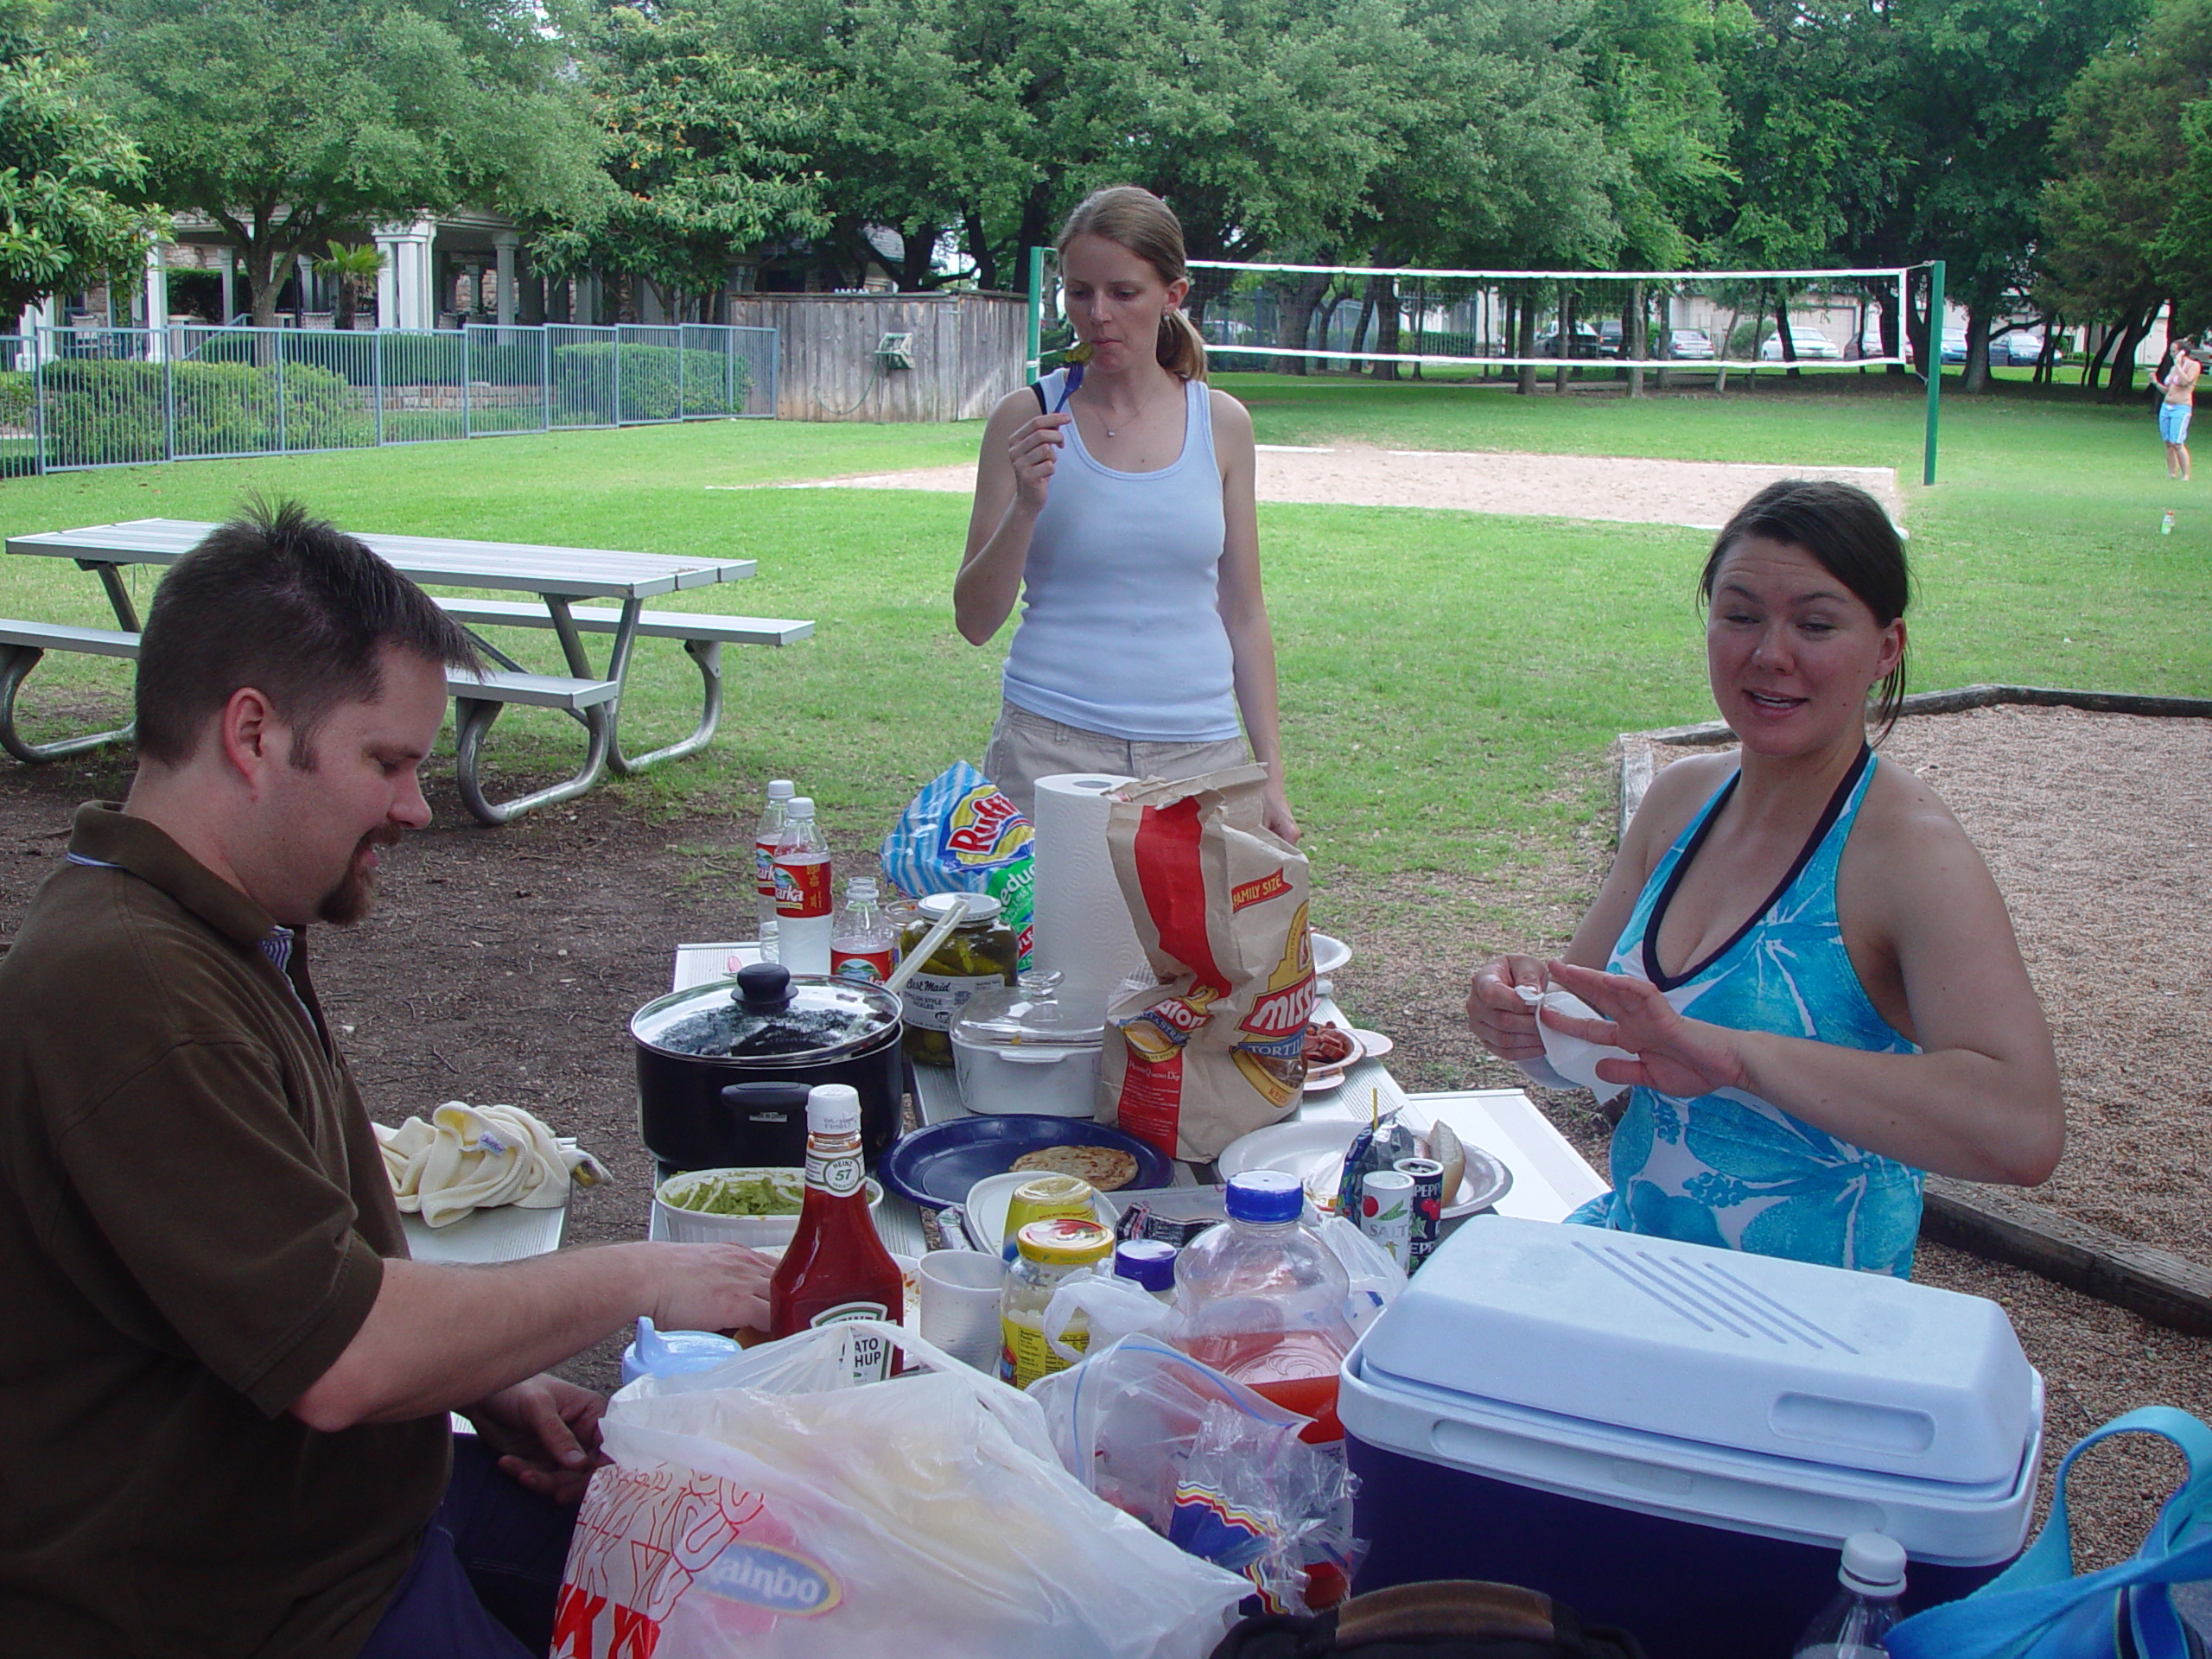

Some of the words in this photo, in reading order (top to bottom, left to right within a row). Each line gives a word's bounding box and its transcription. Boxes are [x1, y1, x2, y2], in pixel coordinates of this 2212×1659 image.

[1233, 884, 1261, 907] FAMILY
[1262, 874, 1282, 896] SIZE
[906, 977, 924, 991] Best
[924, 980, 951, 992] Maid
[832, 1160, 854, 1168] HEINZ
[835, 1168, 853, 1181] 57
[1369, 1224, 1408, 1238] SALT
[710, 1556, 821, 1605] ainbo
